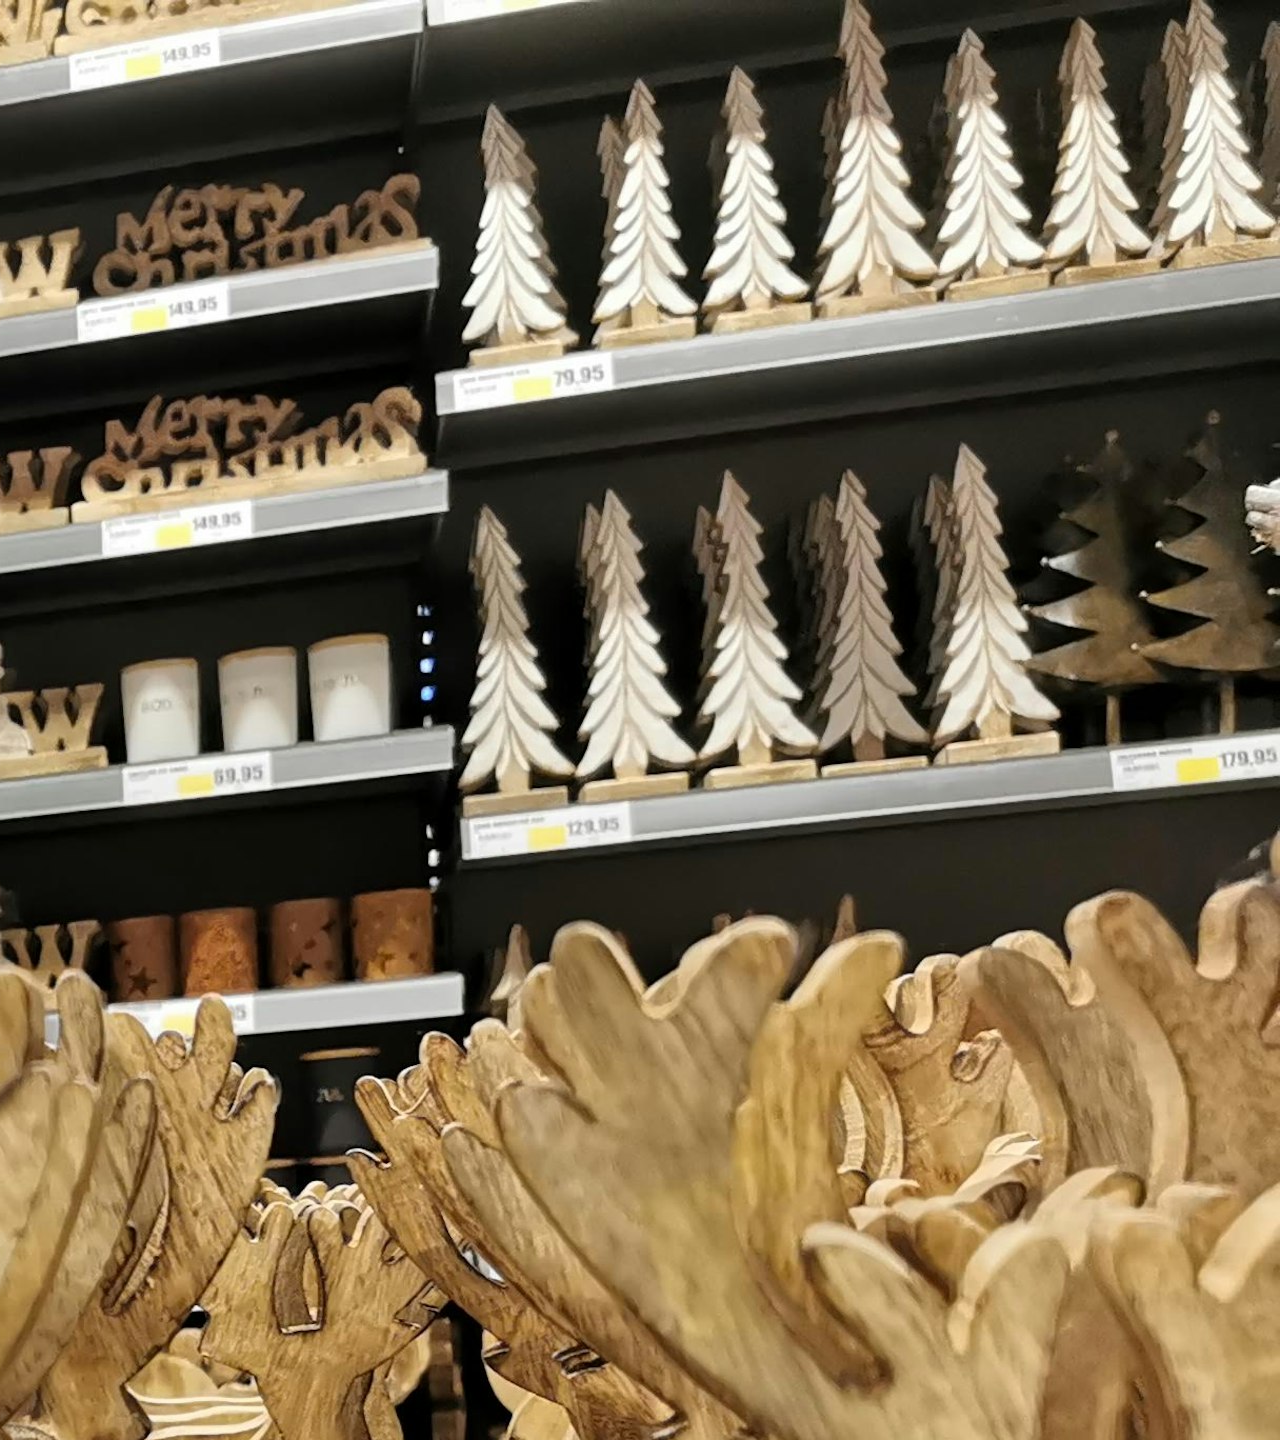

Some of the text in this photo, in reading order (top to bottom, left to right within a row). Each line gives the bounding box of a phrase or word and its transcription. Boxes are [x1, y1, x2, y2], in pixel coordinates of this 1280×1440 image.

[161, 41, 212, 64] 149.95
[167, 297, 218, 318] 149.95
[552, 365, 605, 388] 79.95
[192, 511, 242, 531] 149.95
[1220, 747, 1278, 769] 179.95
[213, 765, 264, 786] 69.95
[566, 817, 620, 838] 129.95
